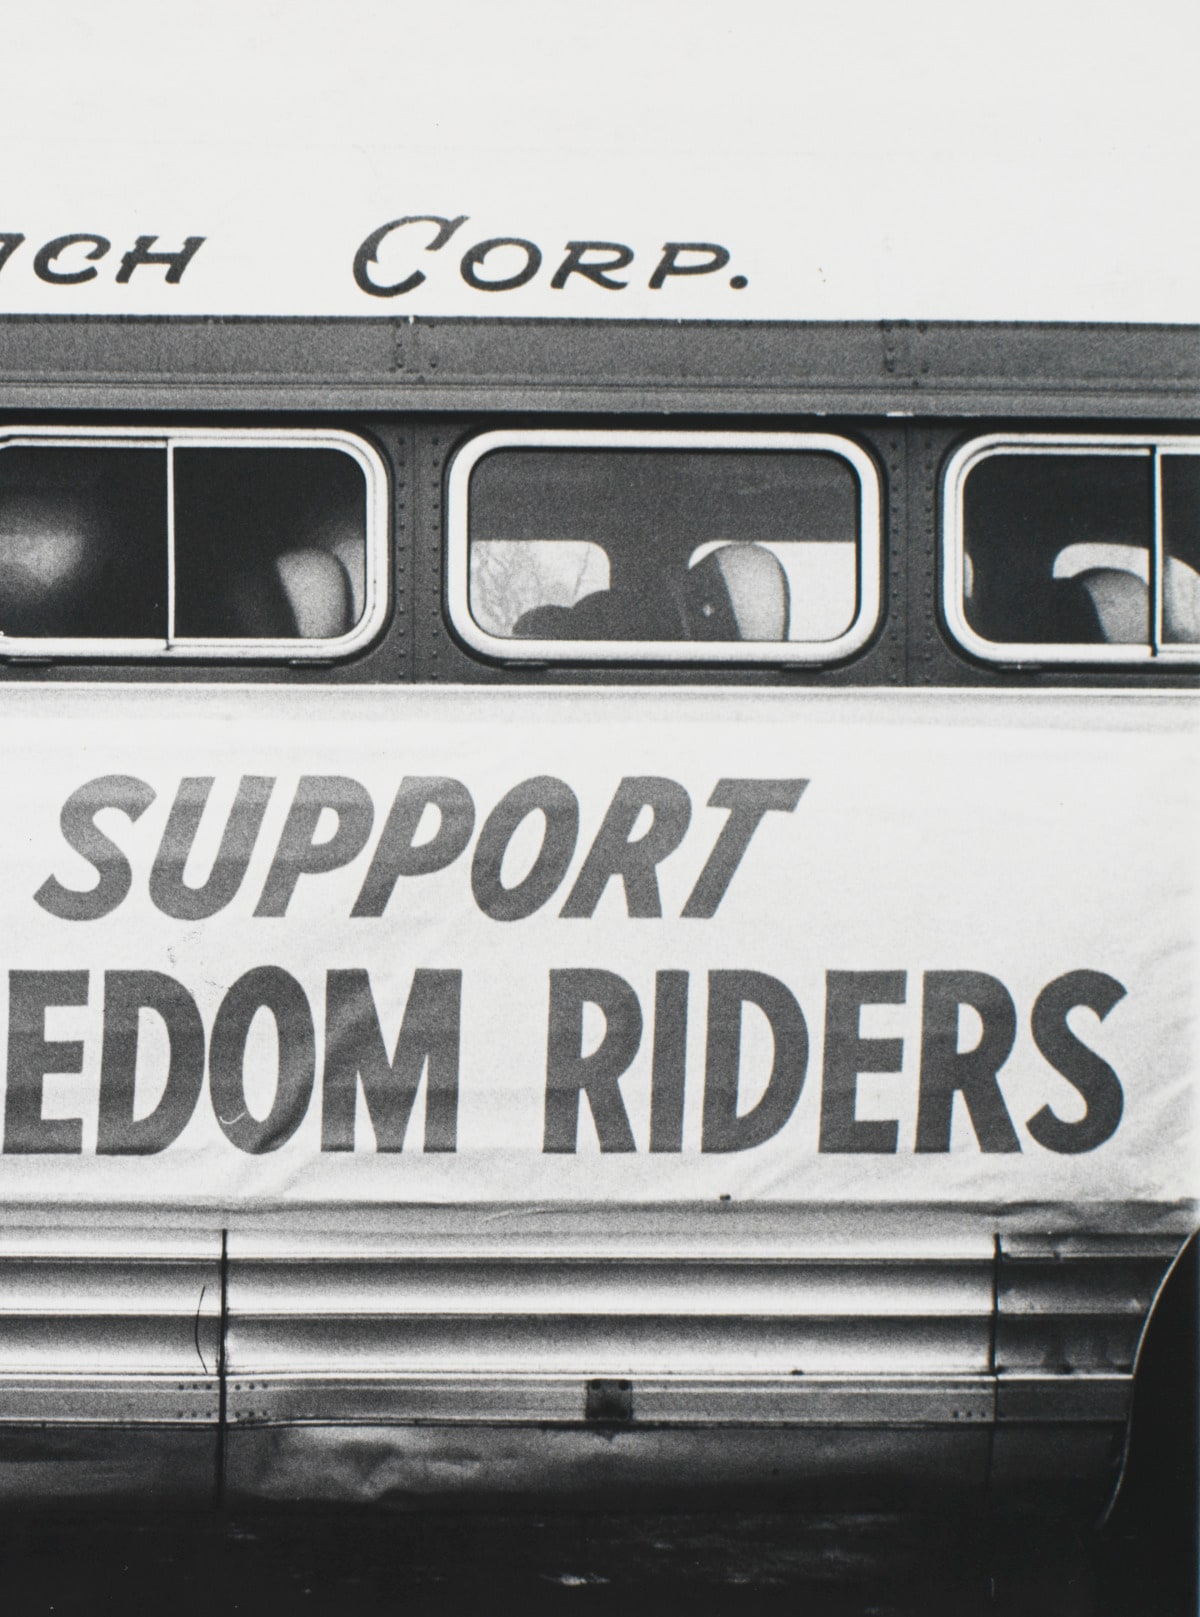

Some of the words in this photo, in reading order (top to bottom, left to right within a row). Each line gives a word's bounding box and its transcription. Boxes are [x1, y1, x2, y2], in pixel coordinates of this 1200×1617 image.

[353, 214, 748, 297] CORP.
[34, 775, 808, 922] SUPPORT
[543, 968, 1128, 1154] RIDERS
